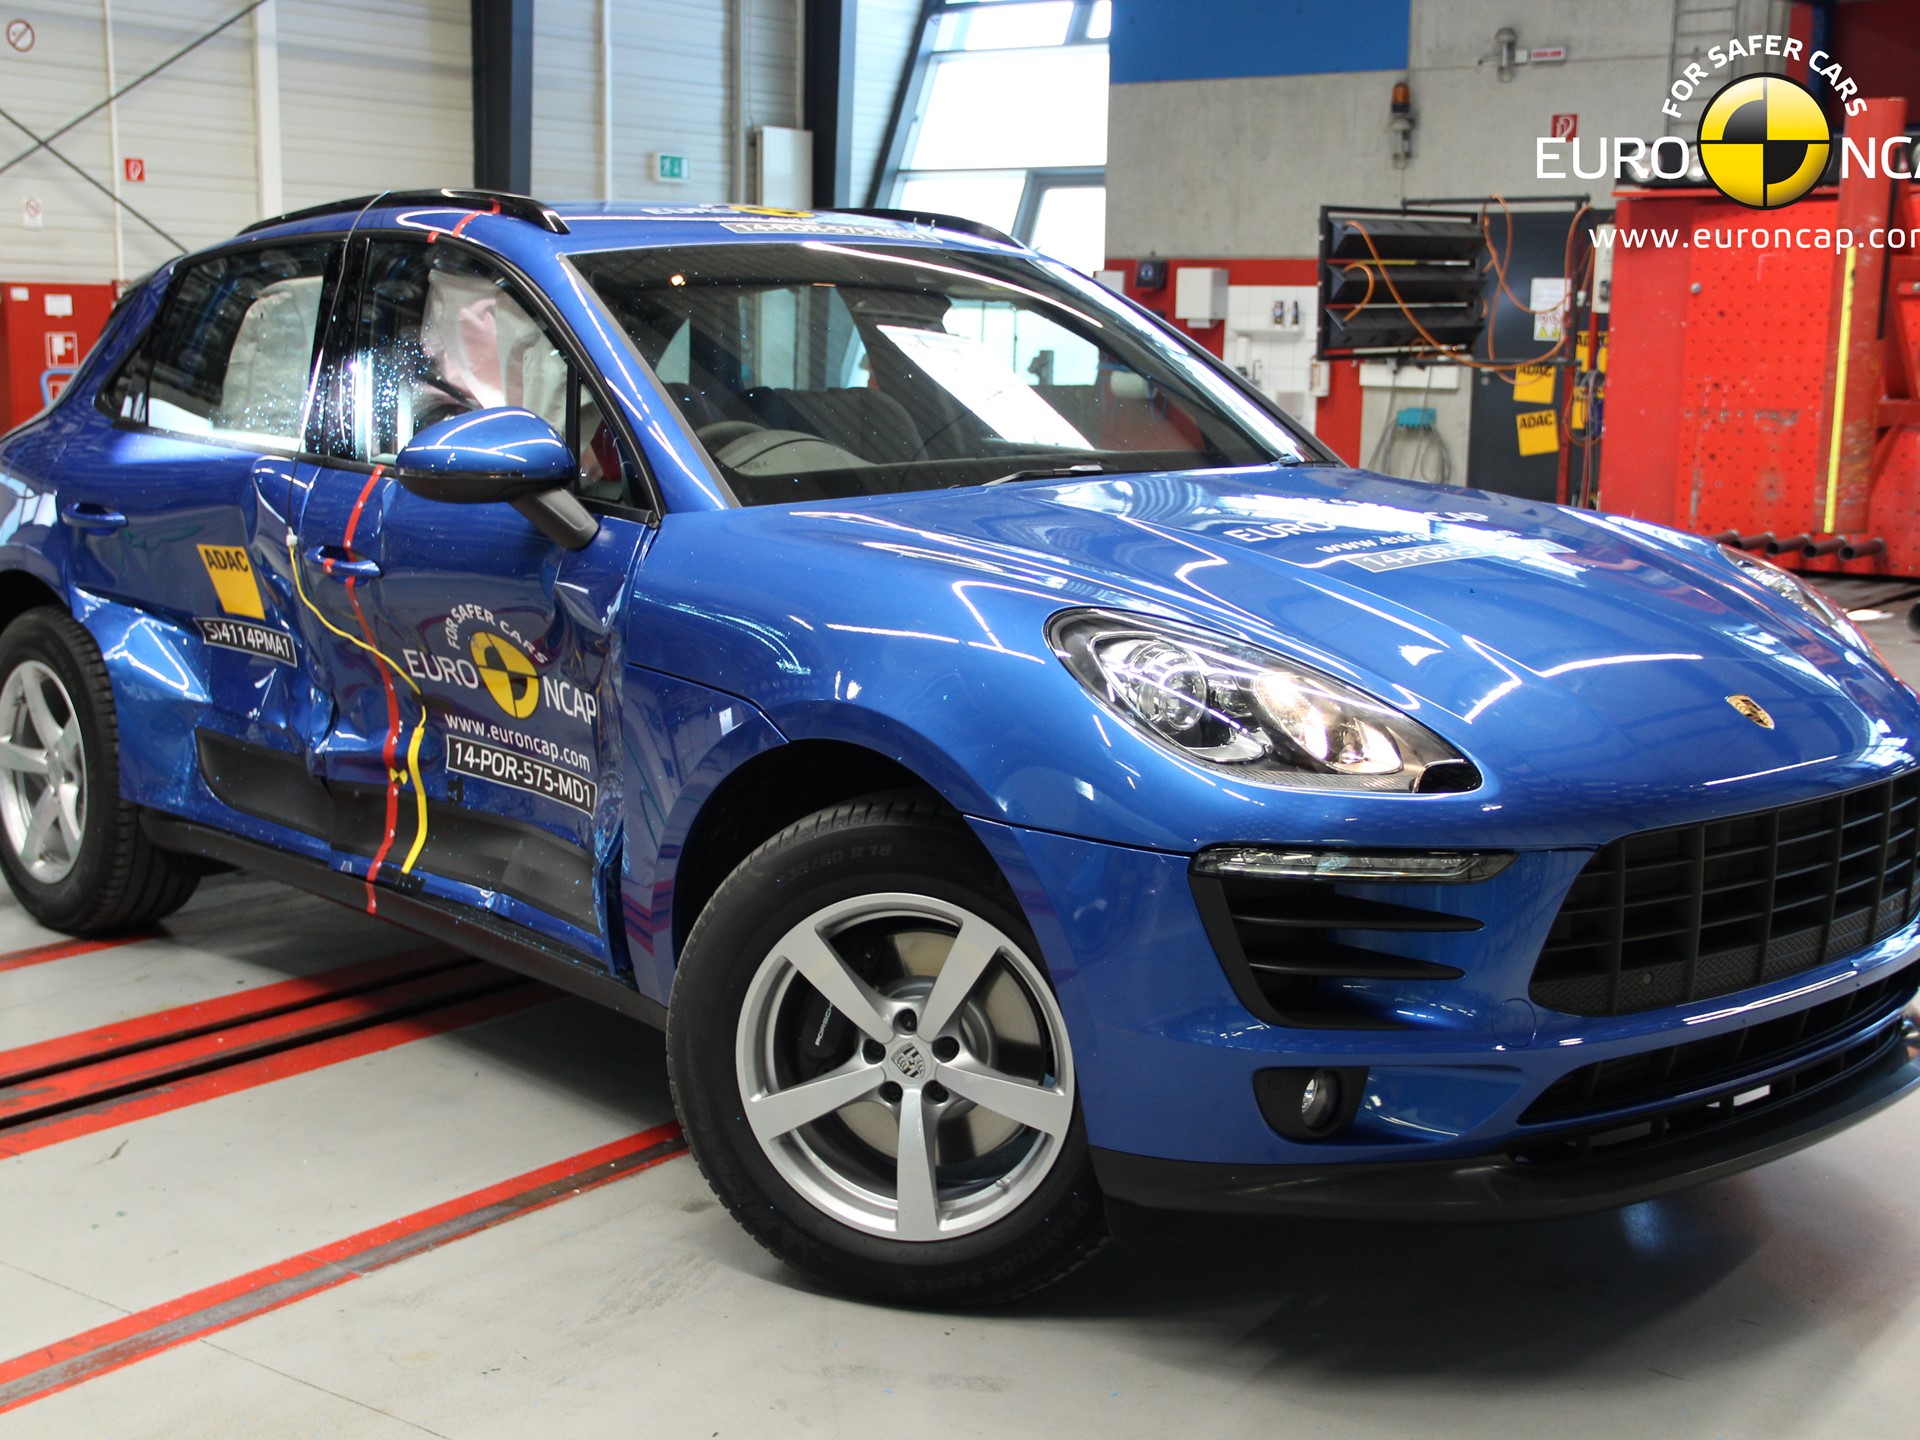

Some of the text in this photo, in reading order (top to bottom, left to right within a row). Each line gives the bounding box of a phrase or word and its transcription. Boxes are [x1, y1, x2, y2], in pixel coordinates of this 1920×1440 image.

[1520, 413, 1553, 430] ADAC
[1223, 520, 1337, 543] EURO
[204, 549, 249, 573] ADAC
[445, 603, 549, 664] FOR SAFER CARS
[402, 648, 597, 725] EURO NCAP
[444, 713, 591, 773] www.euroncap.com
[455, 742, 591, 808] 14-POR-575-MD1
[815, 1002, 833, 1046] PORSCH
